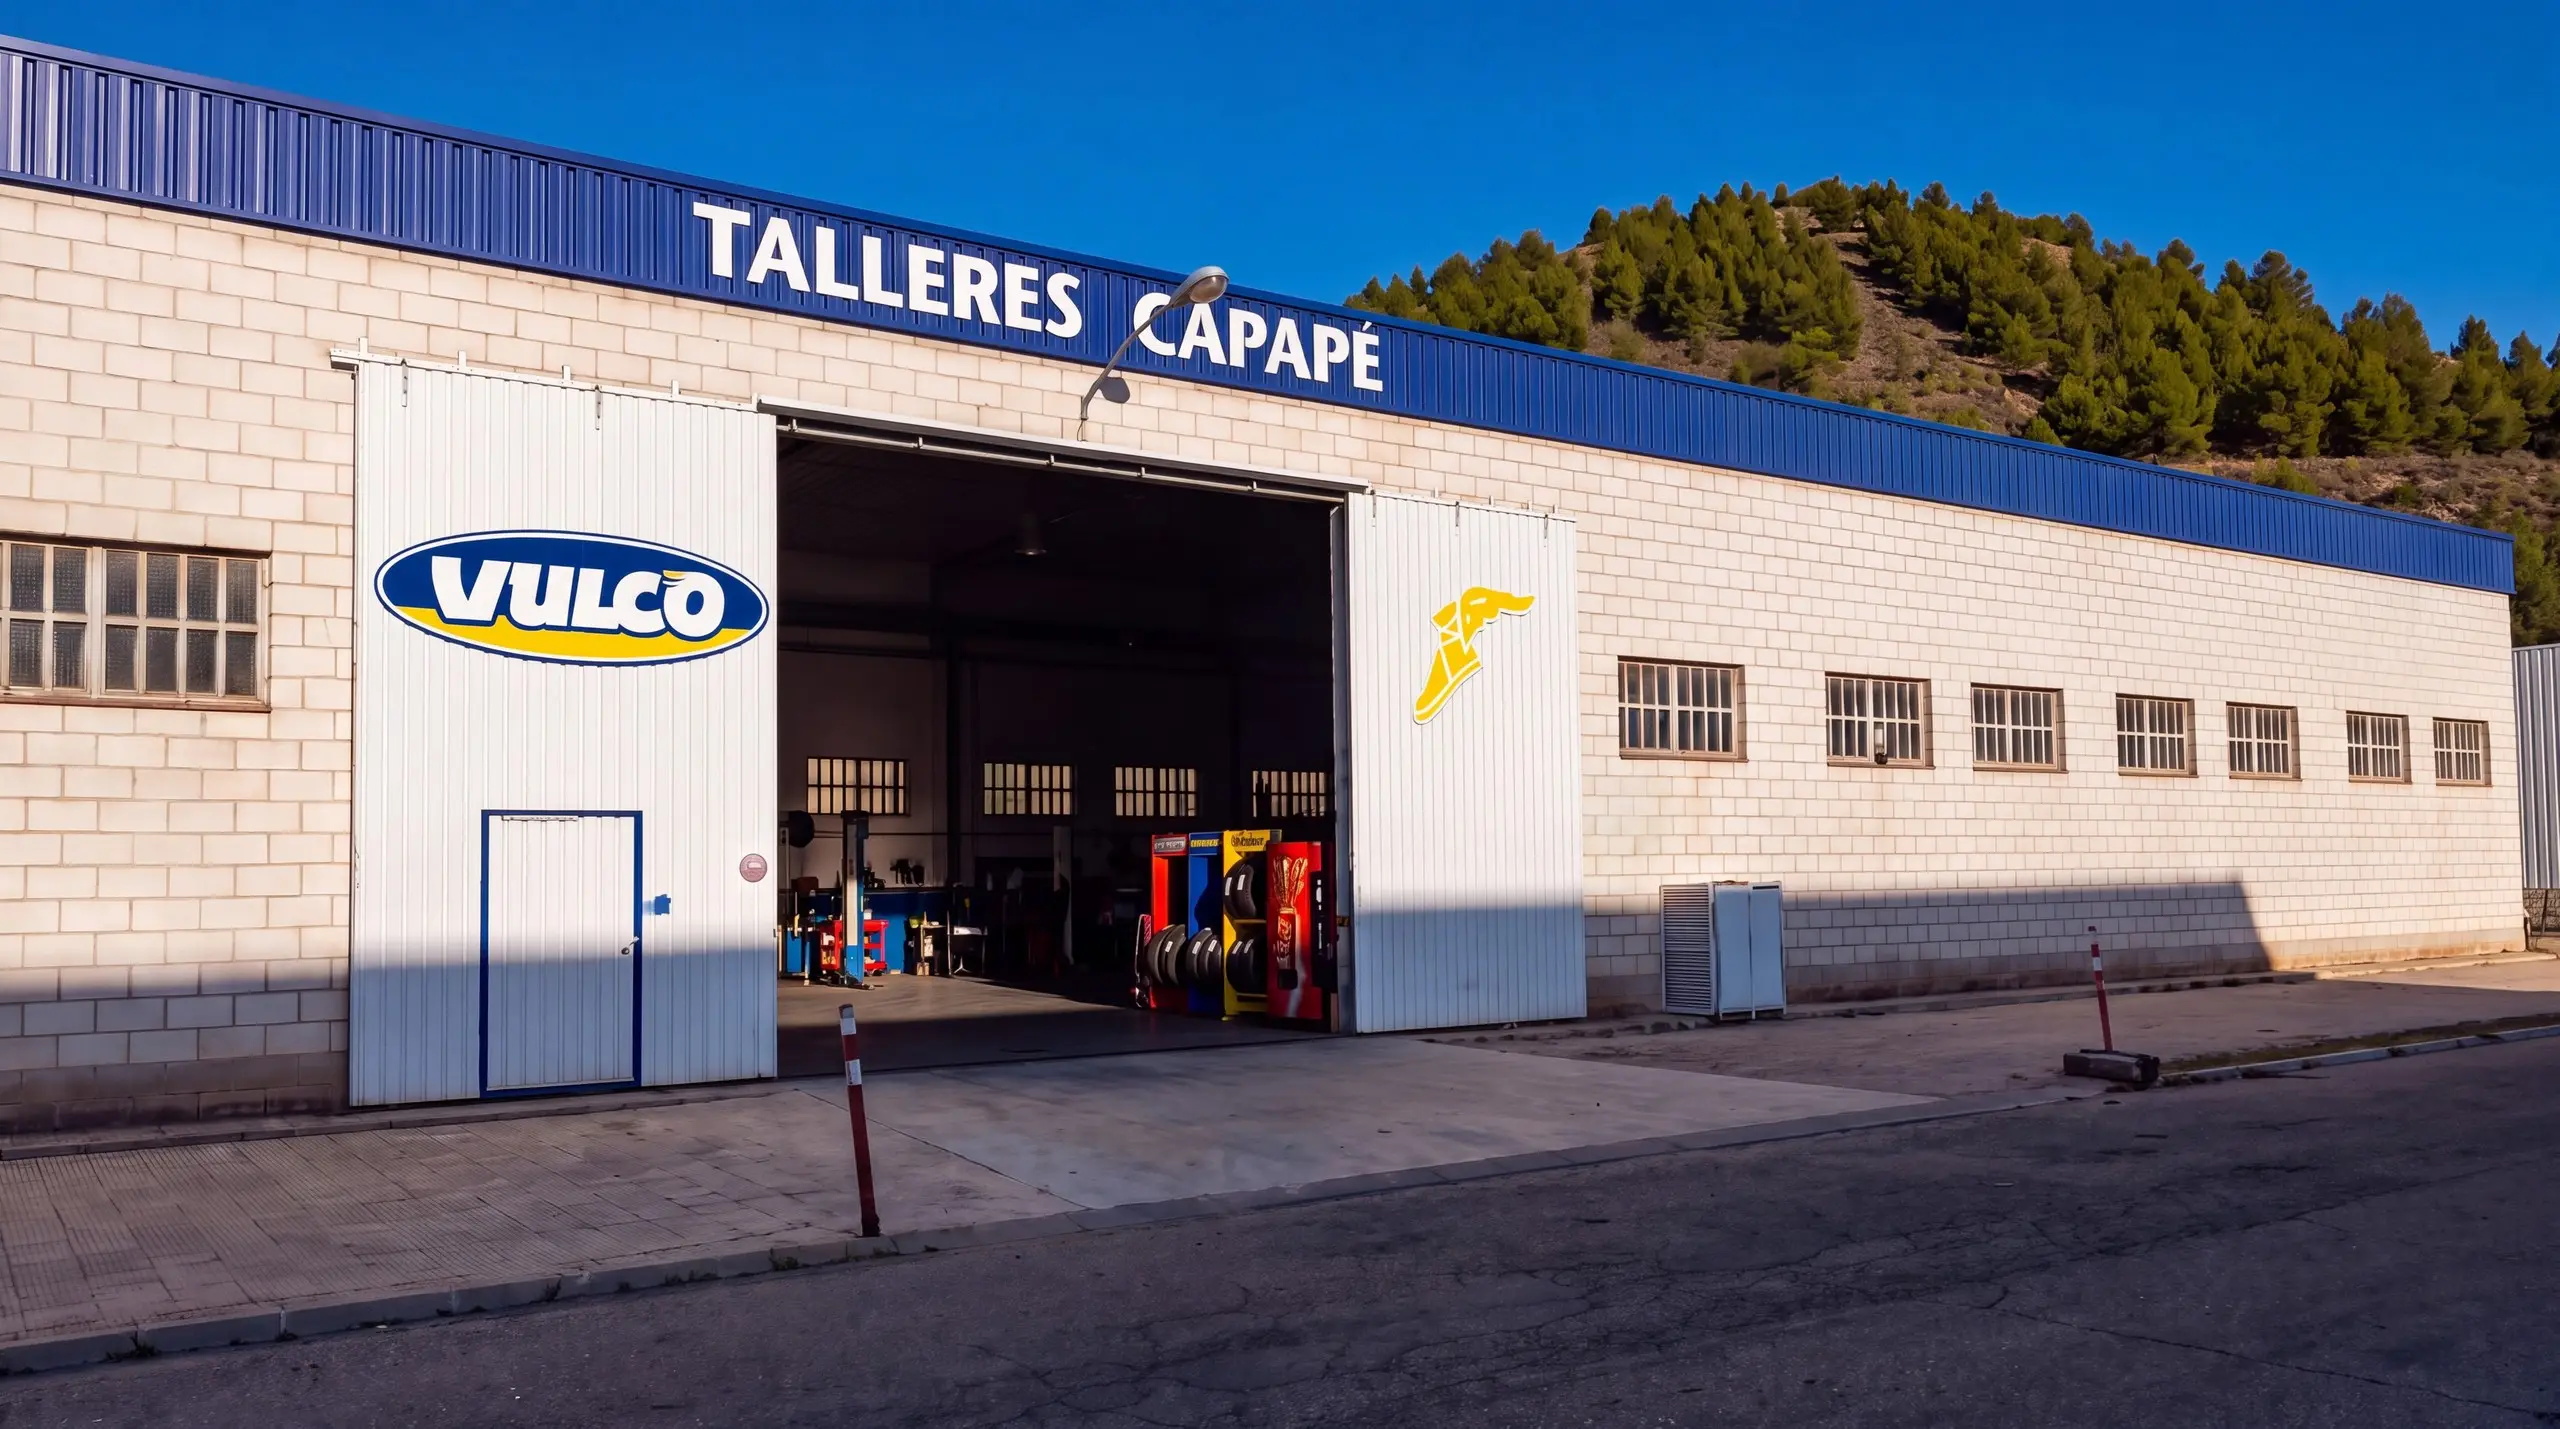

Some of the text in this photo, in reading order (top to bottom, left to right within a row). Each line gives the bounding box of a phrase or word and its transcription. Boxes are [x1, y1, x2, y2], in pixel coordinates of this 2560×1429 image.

[693, 201, 1384, 392] TALLERES CAPAPÉ
[432, 555, 725, 638] VULCO
